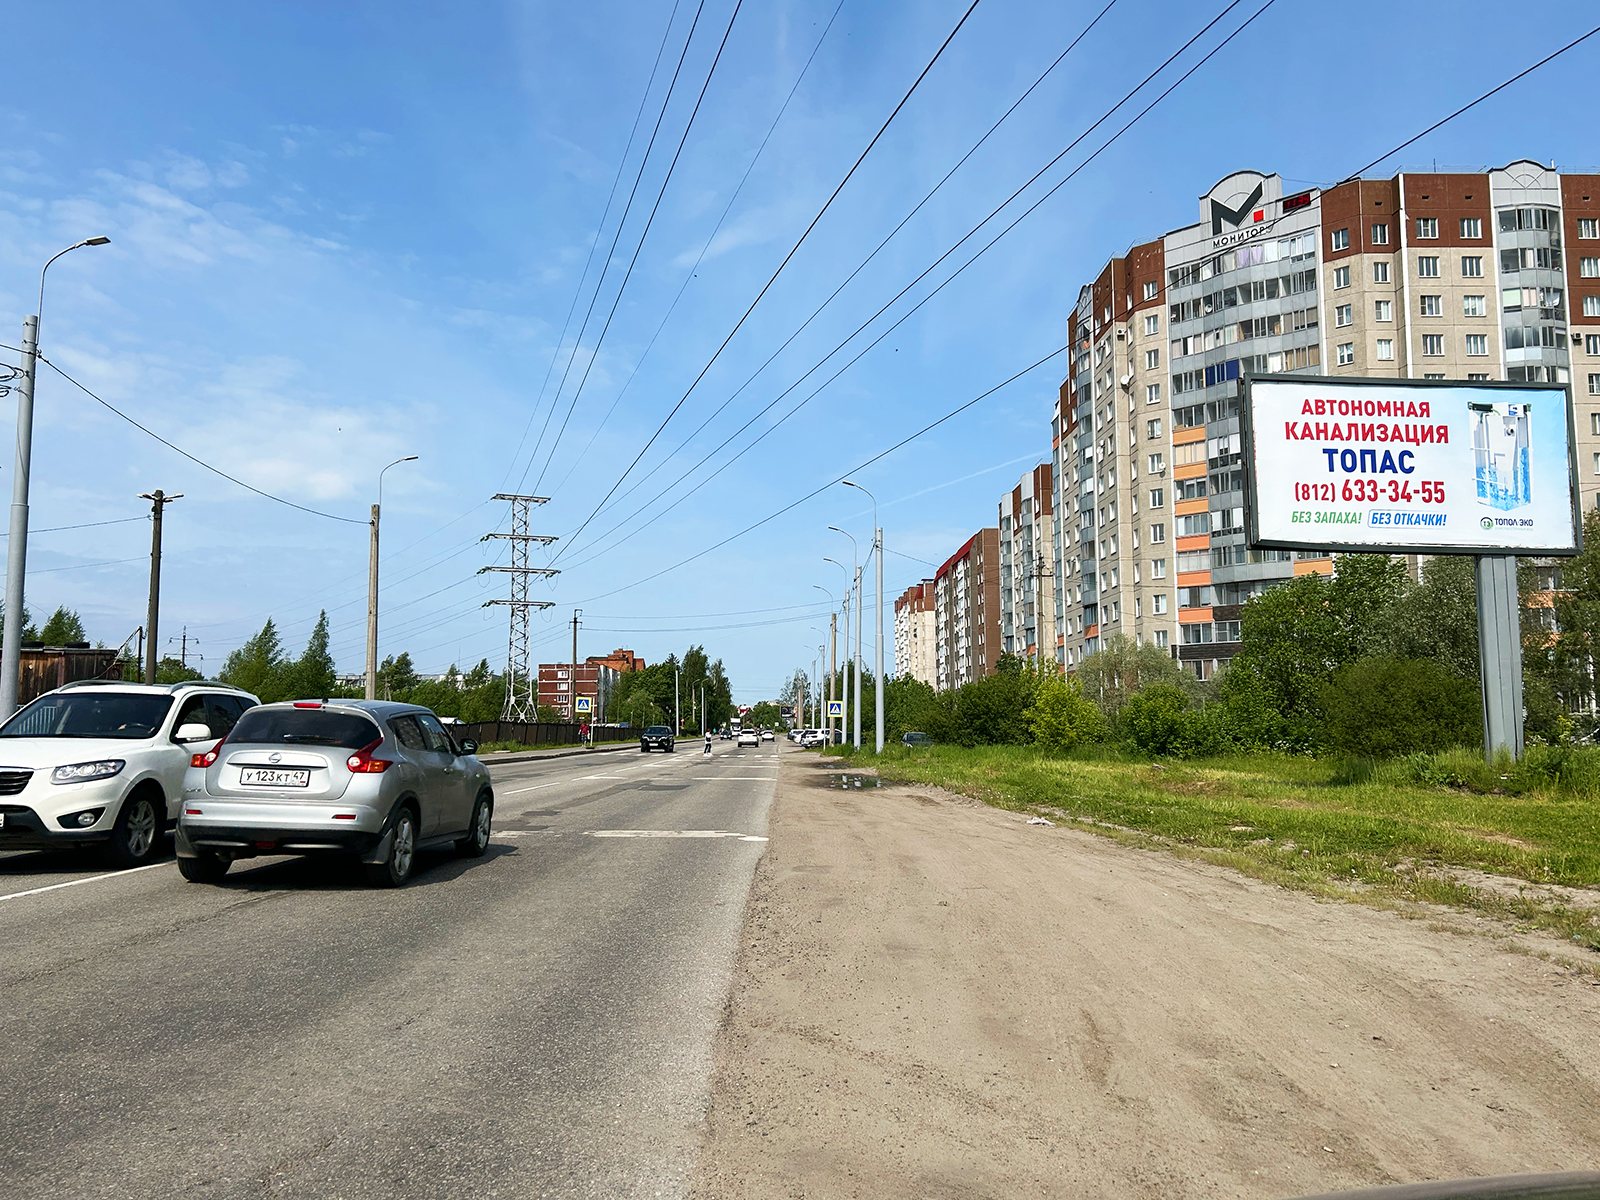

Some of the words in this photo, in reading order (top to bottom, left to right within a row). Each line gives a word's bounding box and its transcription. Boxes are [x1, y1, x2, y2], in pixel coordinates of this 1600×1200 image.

[1213, 226, 1265, 248] МОНИТОР
[1301, 399, 1430, 418] АВТОНОМНАЯ
[1285, 421, 1449, 446] КАНАЛИЗАЦИЯ
[1322, 448, 1415, 474] ТОПАС
[1295, 482, 1336, 502] (812)
[1341, 479, 1445, 504] 633-34-55
[1291, 510, 1313, 523] БЕЗ
[1314, 511, 1362, 525] ЗАПАХА!
[1371, 512, 1392, 525] БЕЗ
[1394, 513, 1447, 527] ОТКАЧКИ!
